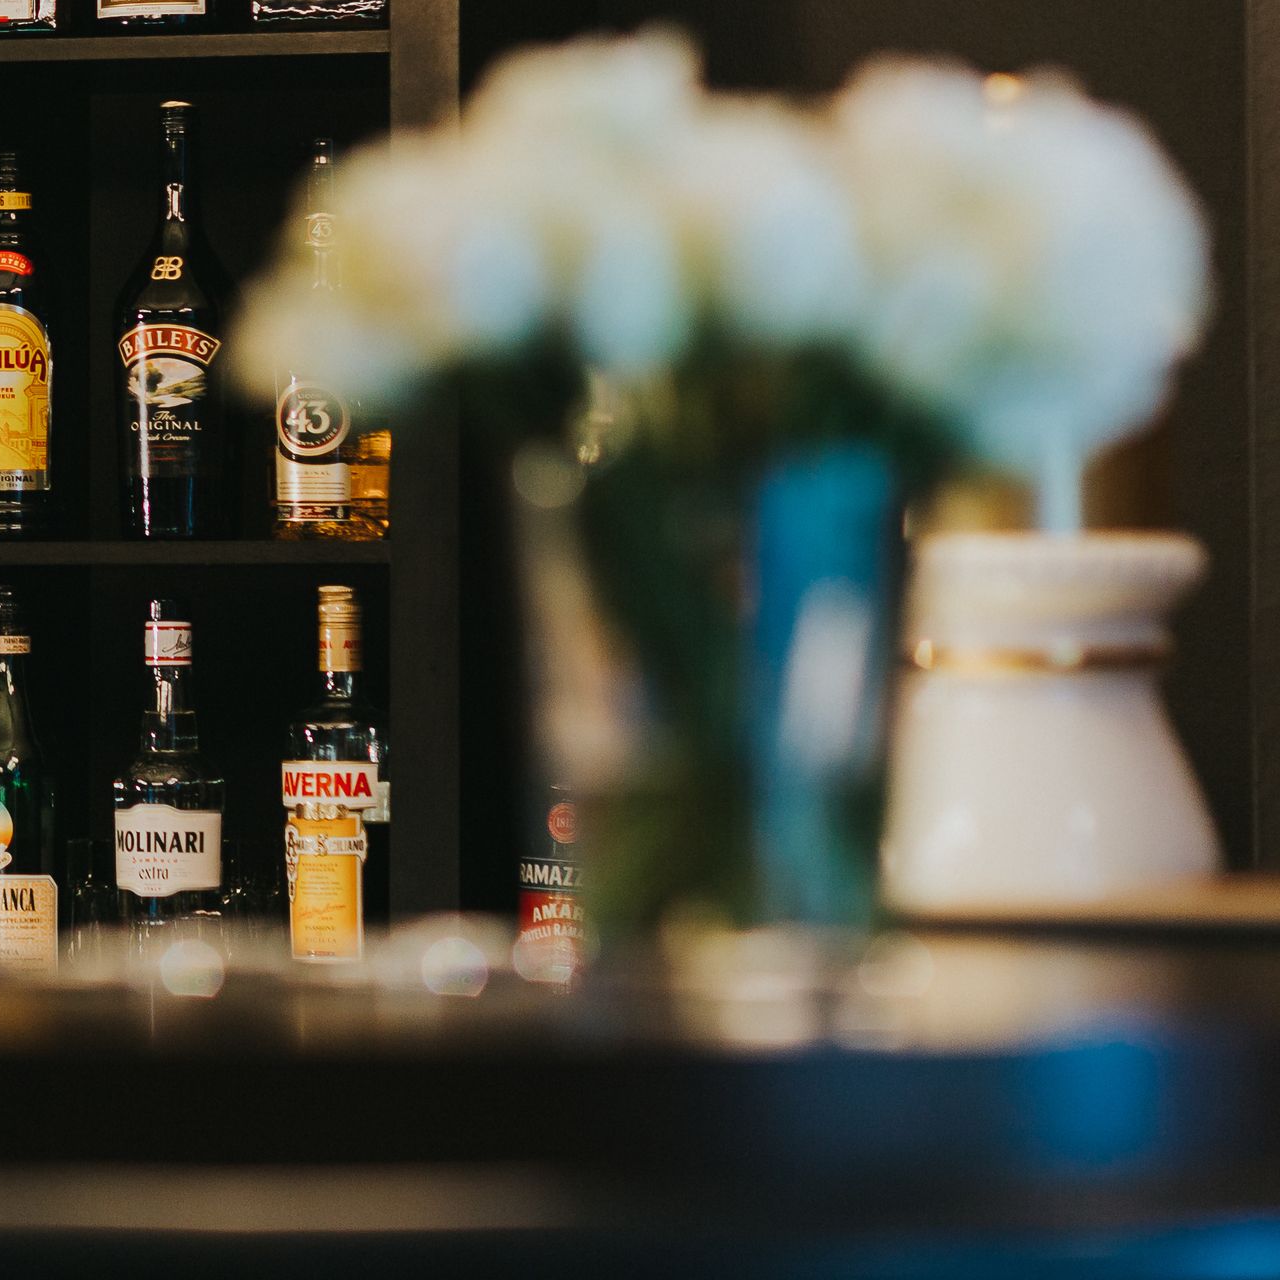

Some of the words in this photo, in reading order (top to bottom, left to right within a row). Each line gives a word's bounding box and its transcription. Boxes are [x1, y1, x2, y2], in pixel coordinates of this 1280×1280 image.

[122, 330, 209, 358] BAILEYS
[152, 410, 176, 420] The
[286, 401, 330, 434] 43
[284, 772, 372, 798] AVERNA
[117, 830, 204, 853] MOLINARI
[138, 867, 168, 880] extra
